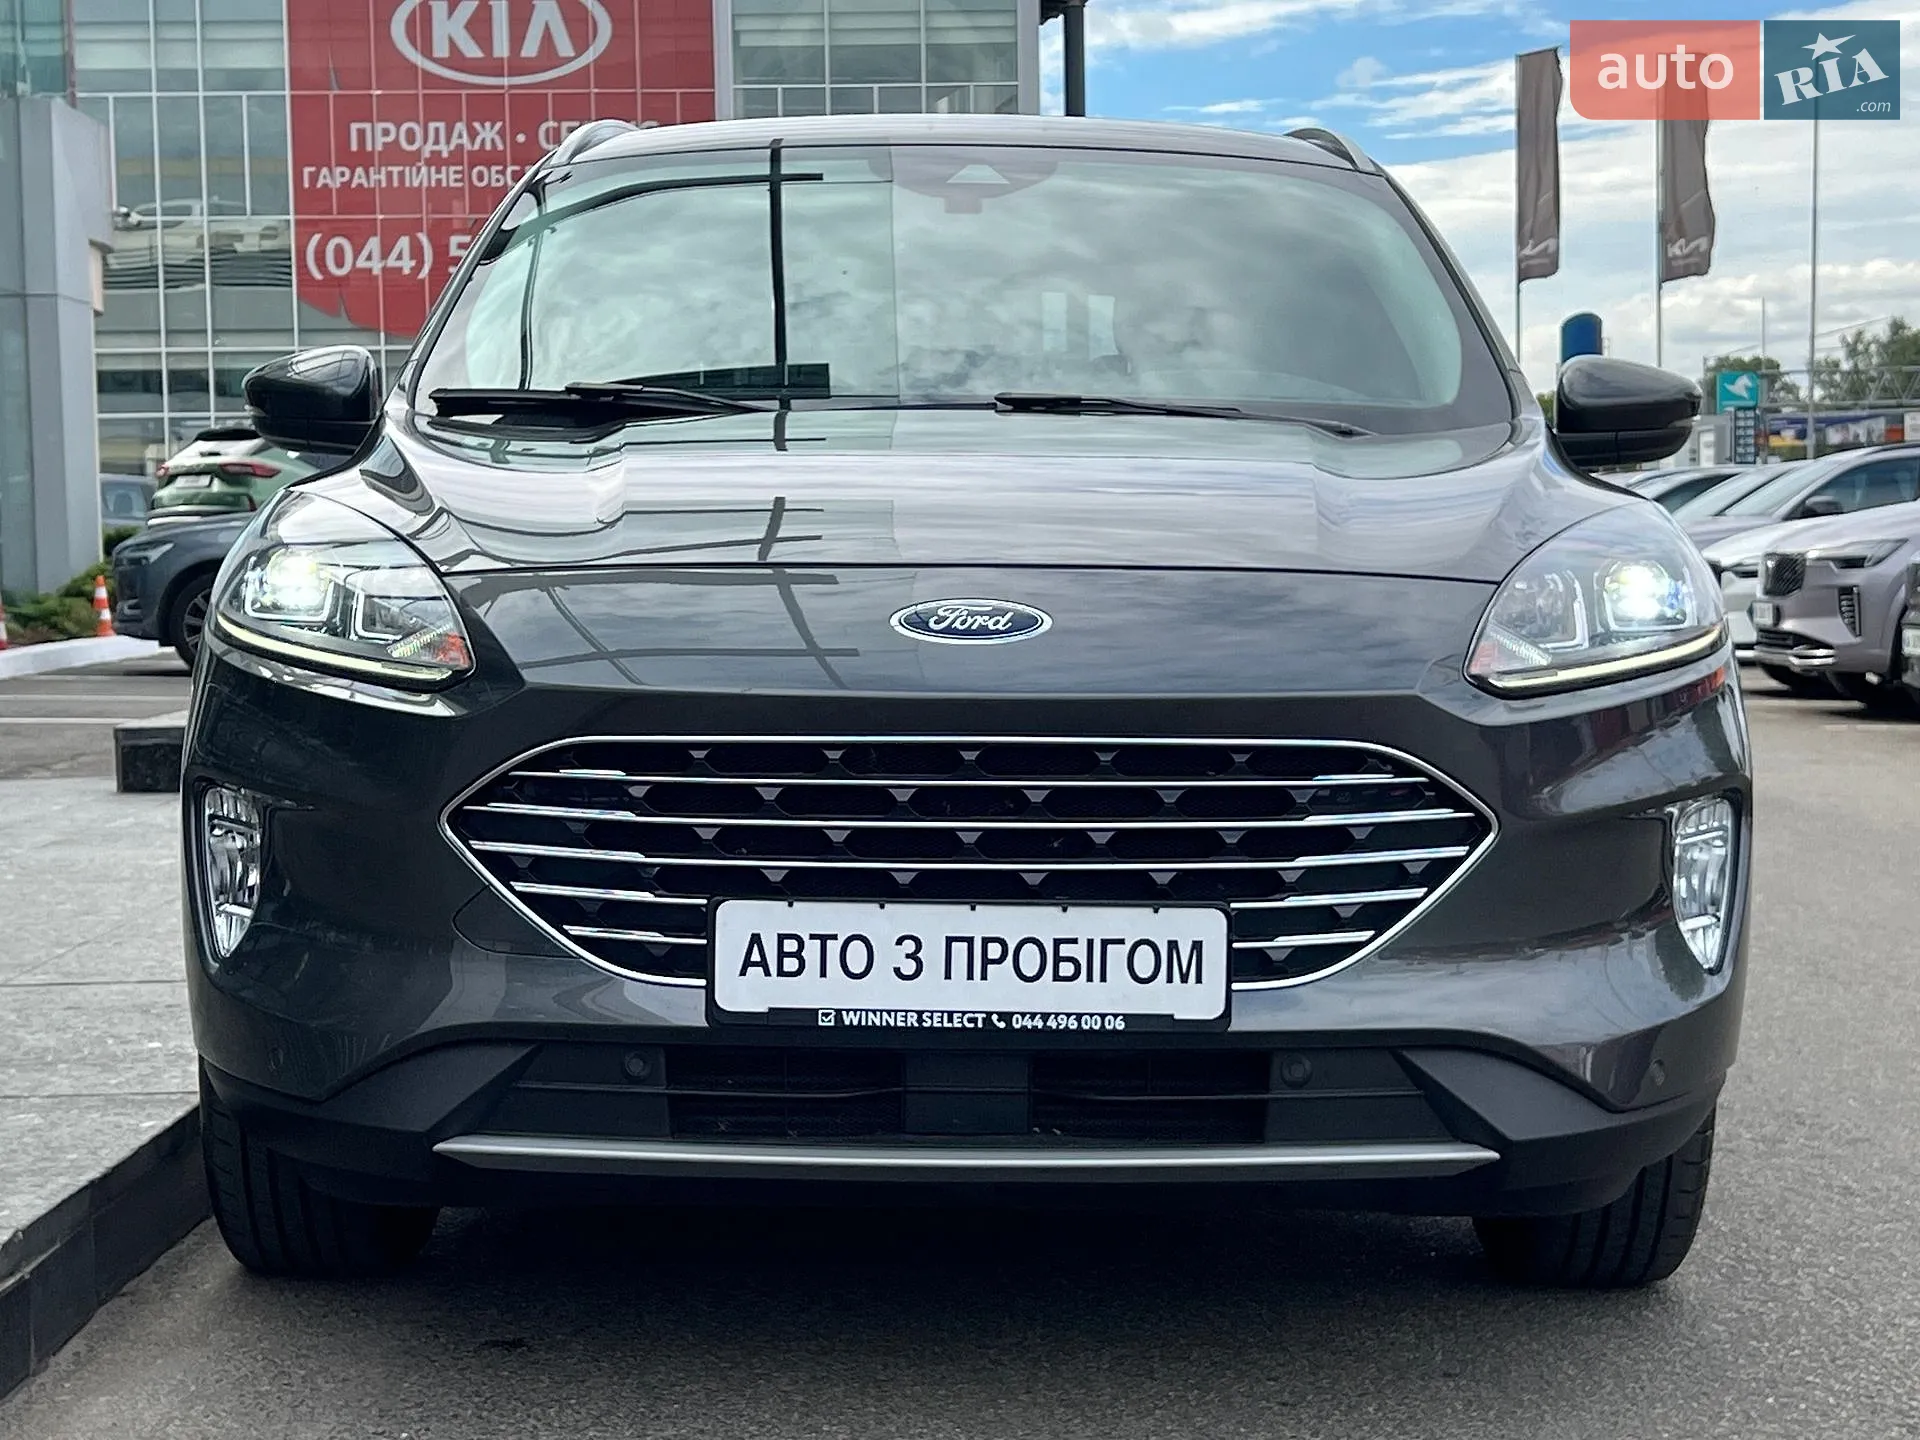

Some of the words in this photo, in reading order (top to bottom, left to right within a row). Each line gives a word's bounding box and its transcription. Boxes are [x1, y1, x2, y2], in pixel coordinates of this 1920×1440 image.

[428, 0, 577, 58] KIA
[350, 121, 504, 158] ПРОДАЖ
[302, 161, 465, 189] ГАРАНТІЙНЕ
[305, 232, 434, 280] (044)
[928, 604, 1014, 631] Ford
[739, 932, 875, 981] АВТО
[944, 935, 1204, 985] ПРОБІГОМ
[841, 1010, 919, 1027] WINNER
[922, 1012, 986, 1028] SELECT
[1012, 1013, 1044, 1029] 044
[1047, 1014, 1078, 1030] 496
[1081, 1014, 1102, 1030] 00
[1104, 1015, 1126, 1031] 06
